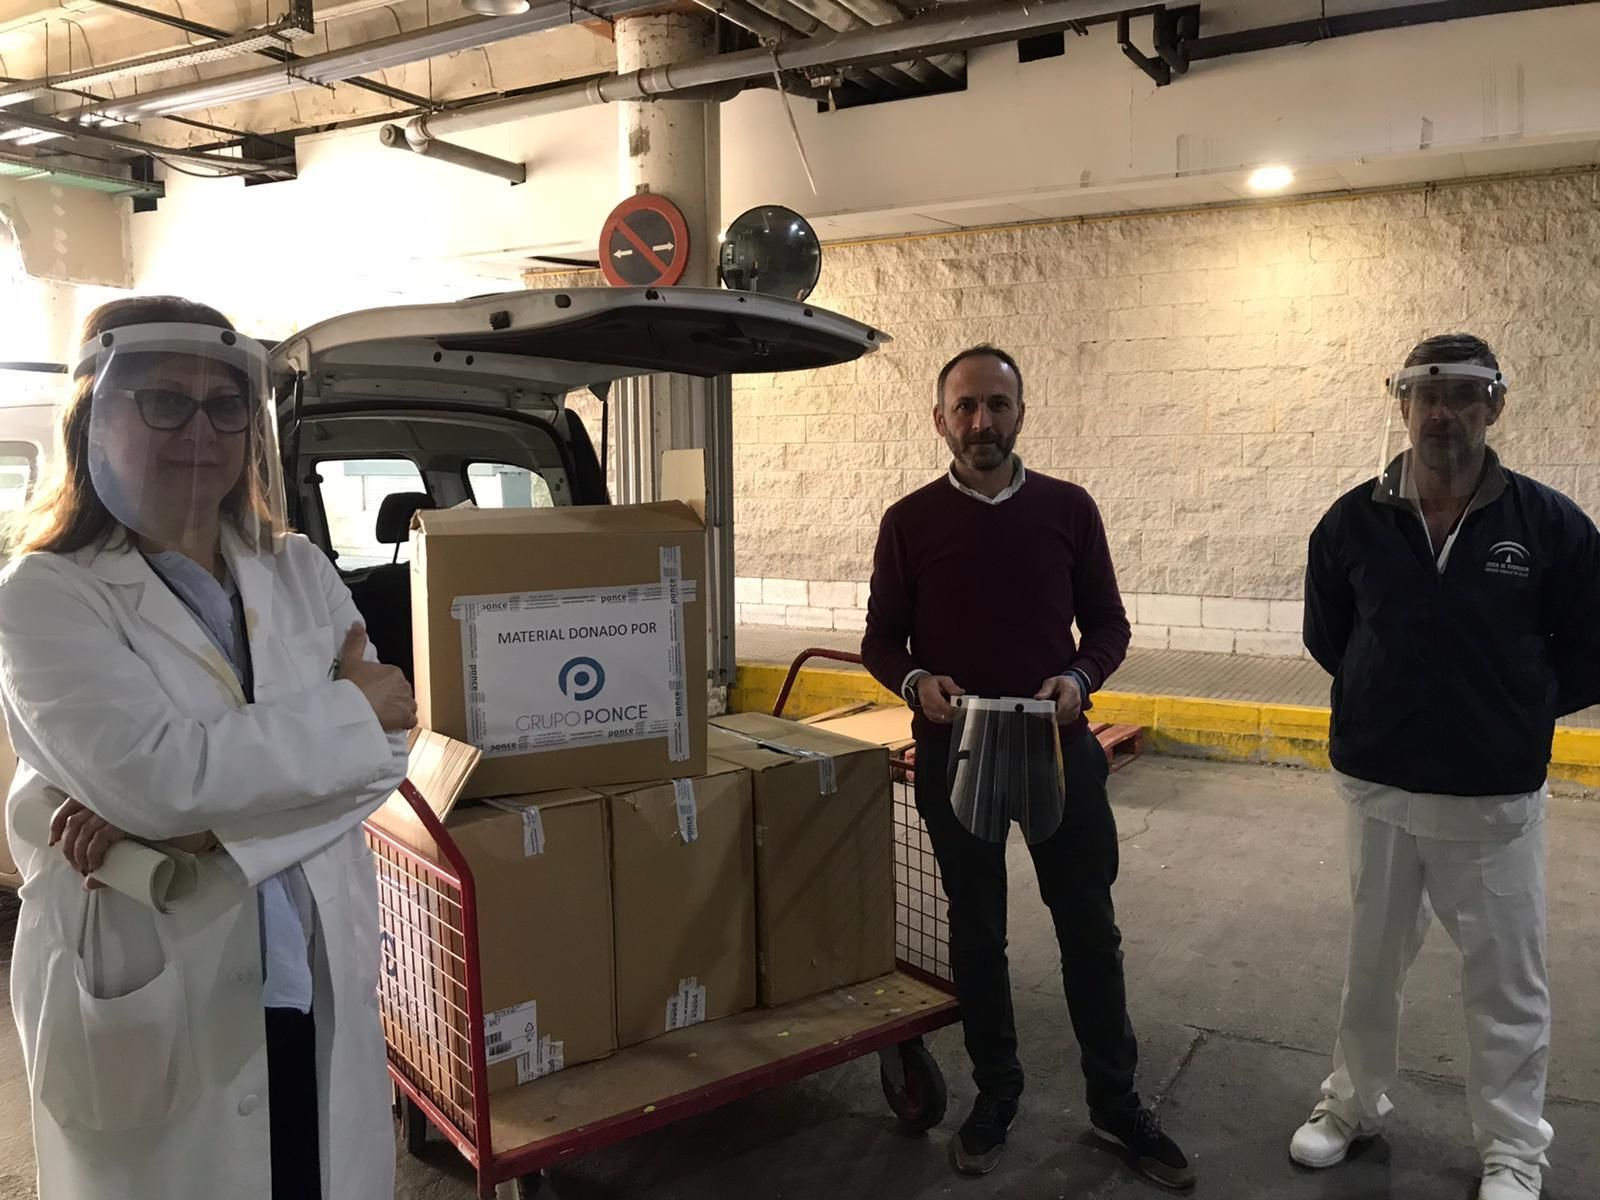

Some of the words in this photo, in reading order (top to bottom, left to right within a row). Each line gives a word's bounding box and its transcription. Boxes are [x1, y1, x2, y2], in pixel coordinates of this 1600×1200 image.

[601, 594, 627, 604] ponce
[669, 578, 678, 604] ponce
[498, 629, 565, 644] MATERIAL
[569, 624, 627, 639] DONADO
[631, 622, 657, 634] POR
[468, 664, 478, 691] ponce
[675, 691, 683, 717] ponce
[515, 710, 581, 731] GRUPO
[584, 704, 648, 725] PONCE
[608, 728, 634, 738] ponce
